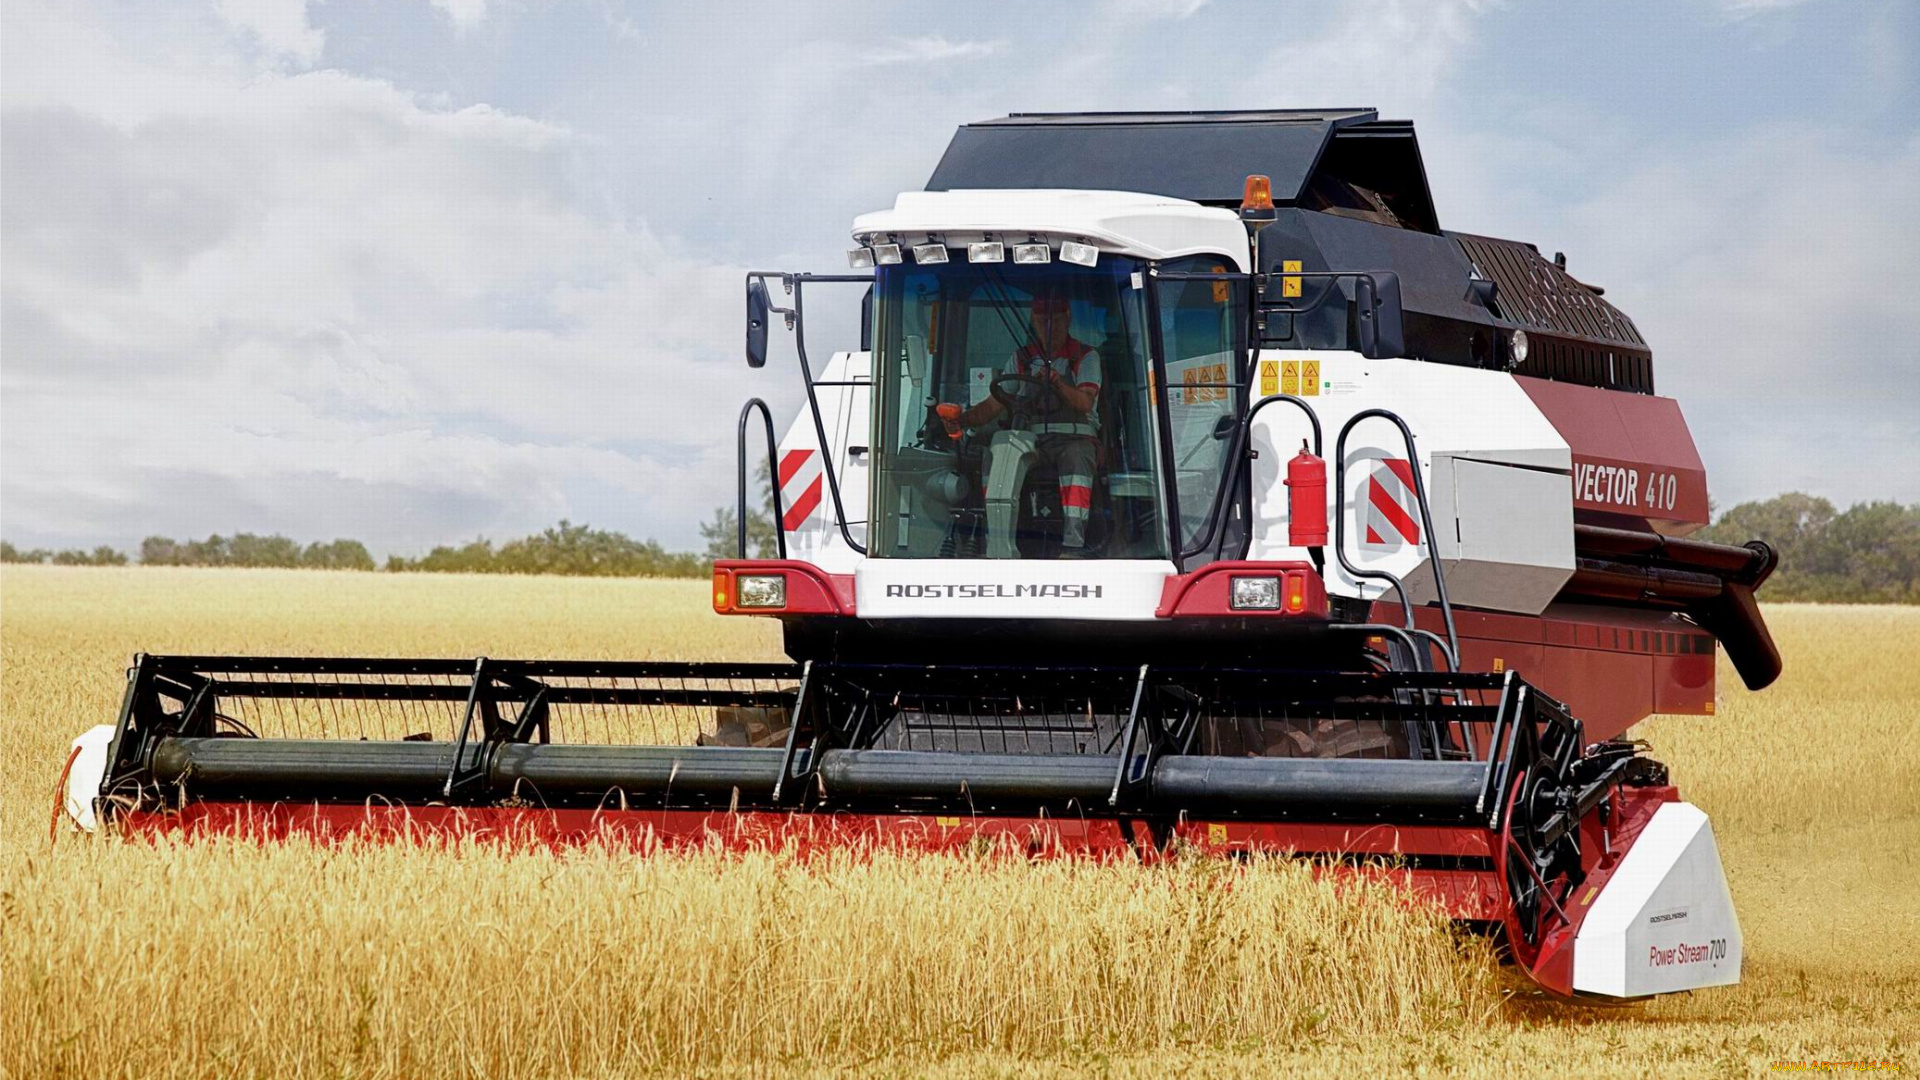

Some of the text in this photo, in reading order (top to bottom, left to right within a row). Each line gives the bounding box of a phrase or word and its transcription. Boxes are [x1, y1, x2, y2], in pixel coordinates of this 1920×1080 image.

[1574, 463, 1676, 511] VECTOR 410
[886, 584, 1103, 598] ROSTSELMASH
[1649, 938, 1727, 967] Power Stream 700
